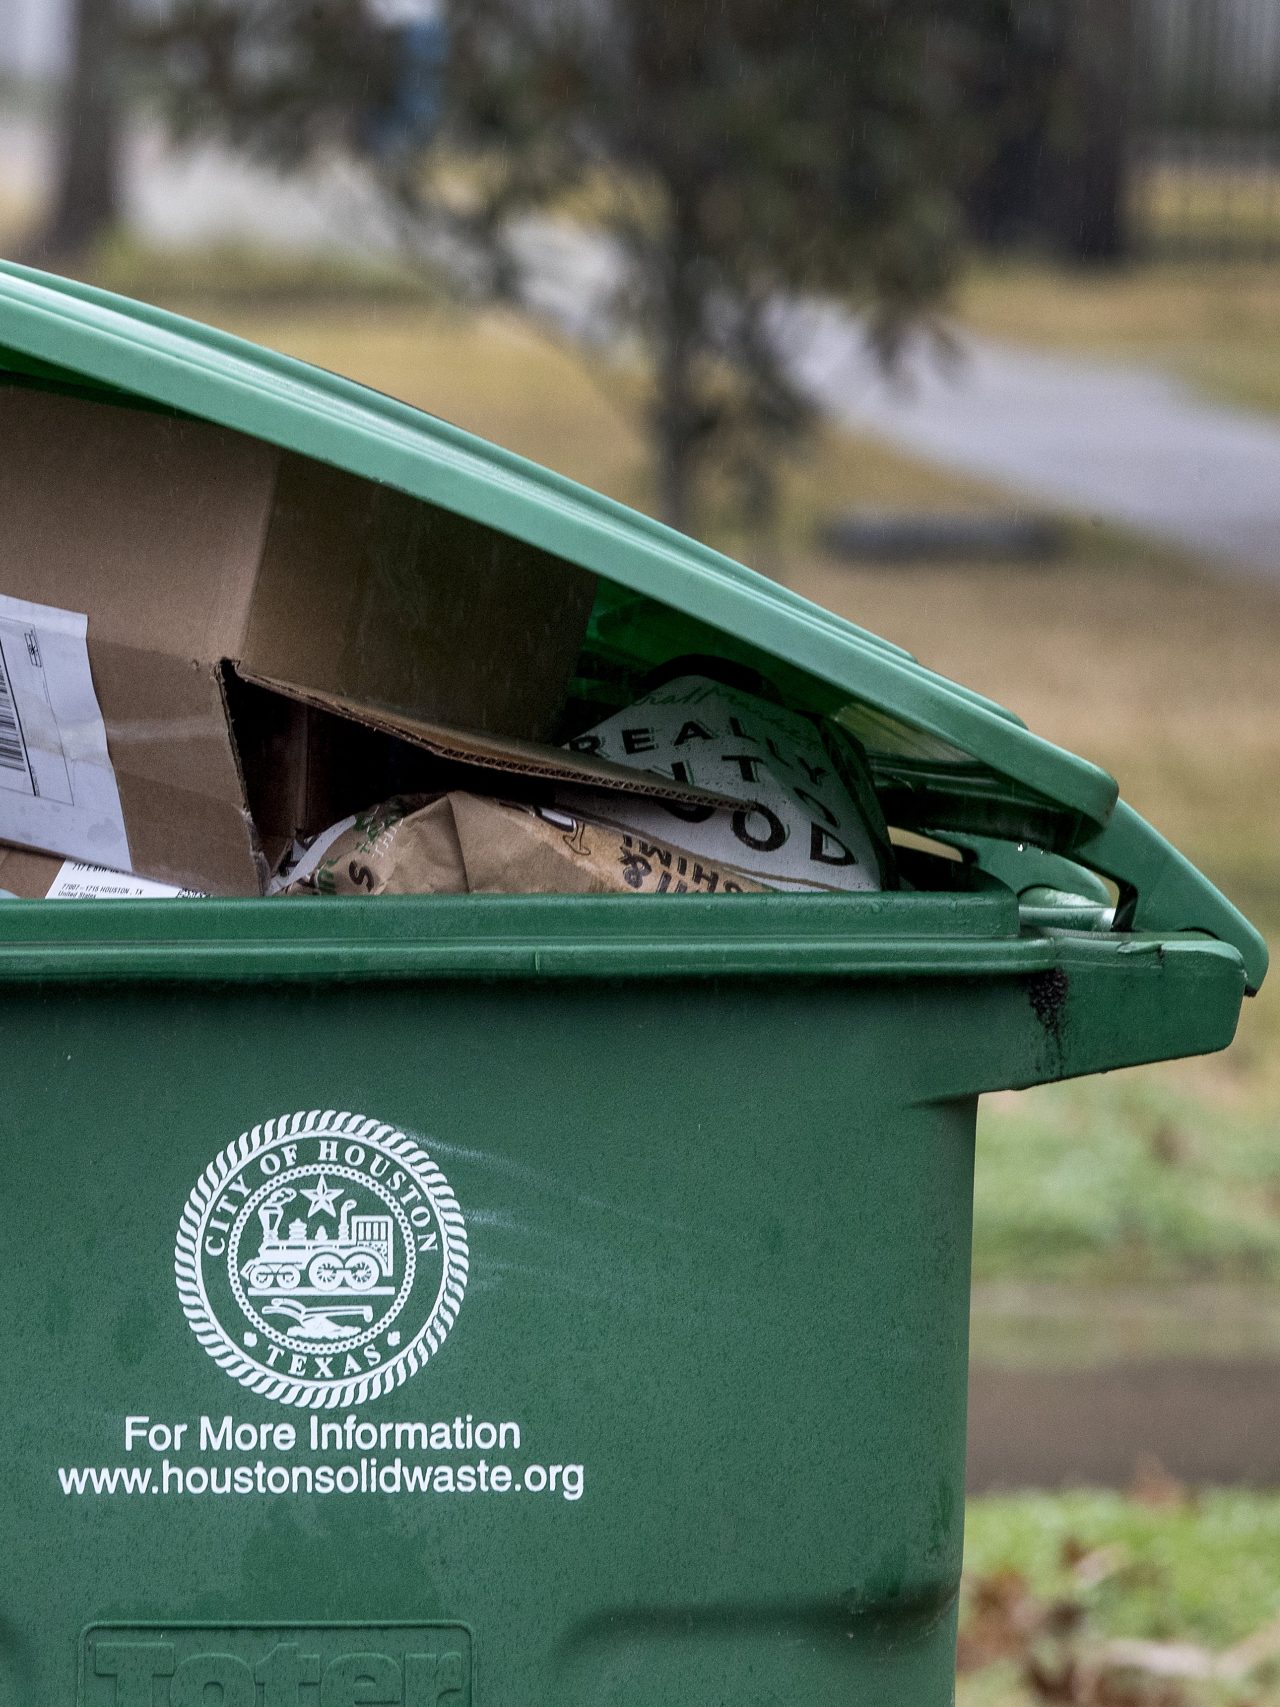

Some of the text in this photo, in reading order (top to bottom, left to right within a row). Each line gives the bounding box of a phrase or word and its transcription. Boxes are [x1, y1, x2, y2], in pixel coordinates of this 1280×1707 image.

[58, 891, 78, 899] United
[100, 886, 130, 895] HOUSTON
[206, 1140, 439, 1257] CITY OF HOUSTON
[266, 1344, 382, 1379] TEXAS
[124, 1413, 521, 1451] For More Information
[58, 1458, 585, 1500] www.houstonsolidwaste.org
